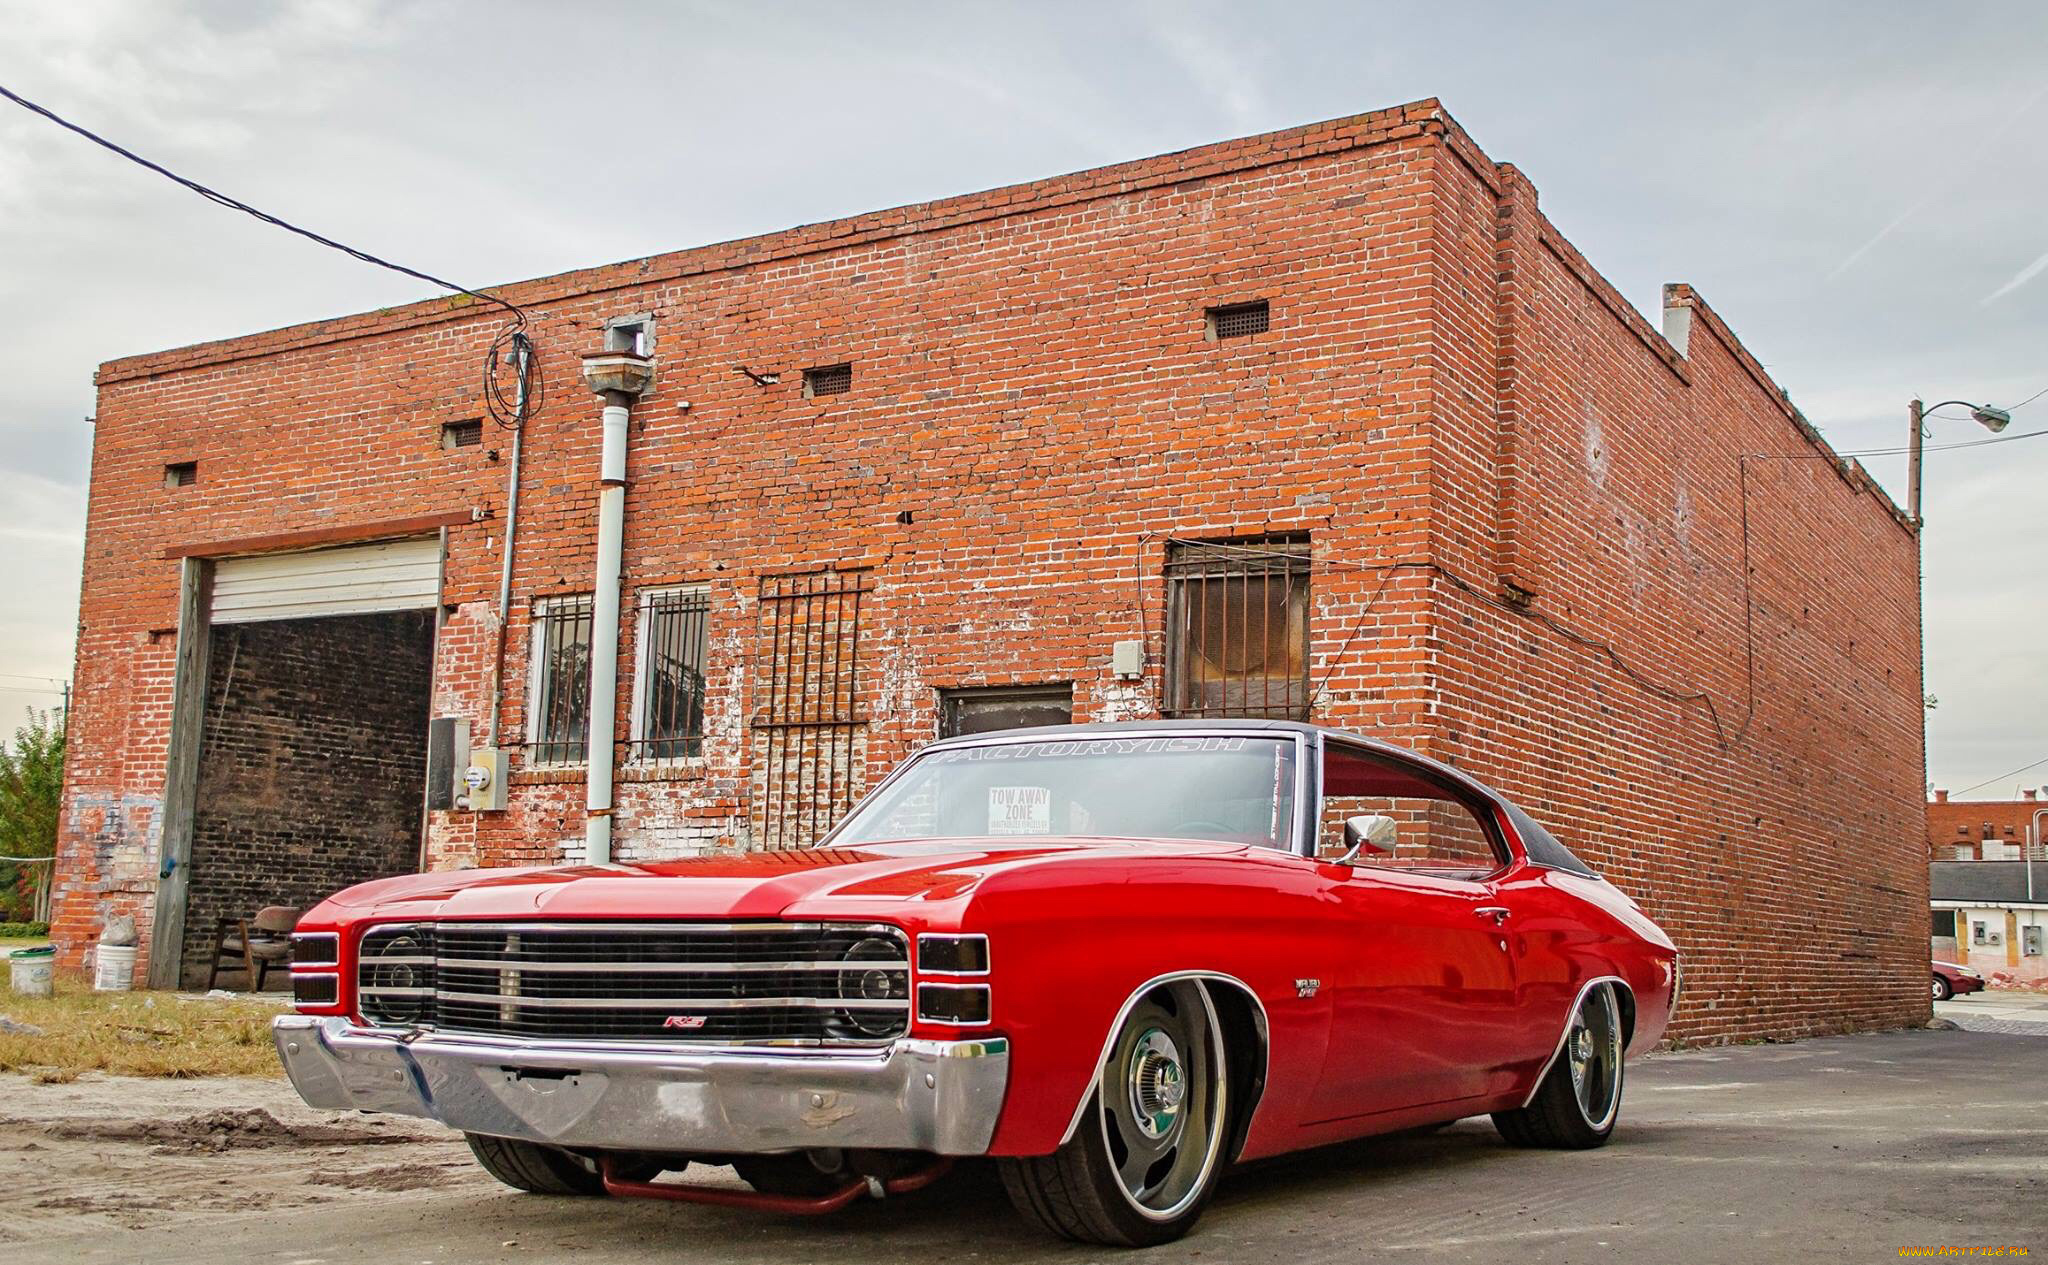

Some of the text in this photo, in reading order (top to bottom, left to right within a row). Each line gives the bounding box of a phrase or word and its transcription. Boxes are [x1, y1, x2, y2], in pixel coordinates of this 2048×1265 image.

[928, 738, 1247, 764] FACTORYISH
[991, 789, 1048, 804] TOW AWAY
[1006, 805, 1032, 820] ZONE
